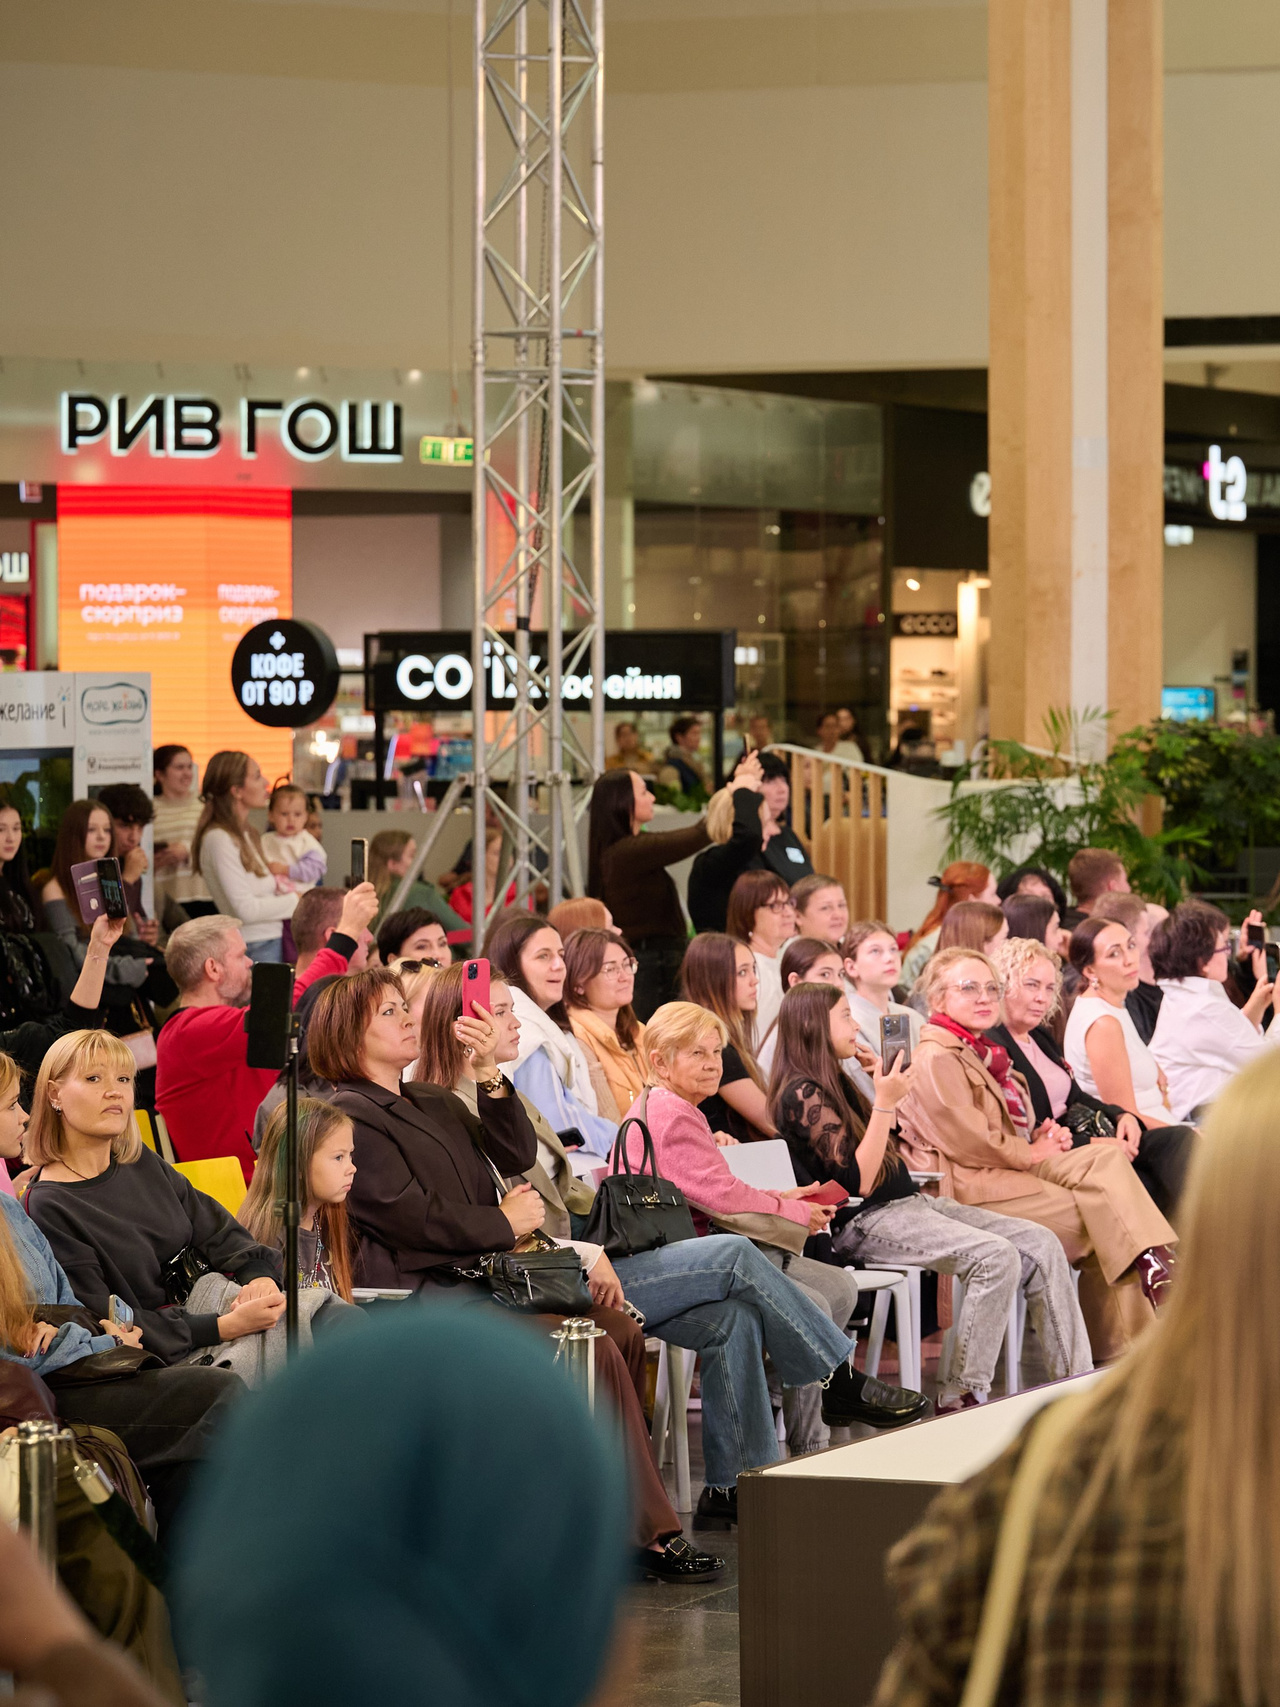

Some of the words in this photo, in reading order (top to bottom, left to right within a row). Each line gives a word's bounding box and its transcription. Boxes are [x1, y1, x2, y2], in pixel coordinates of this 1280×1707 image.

[60, 391, 222, 458] РИВ
[239, 396, 404, 463] ГОШ
[1203, 444, 1247, 521] t2
[79, 583, 188, 604] подарок-
[81, 605, 184, 627] сюрприз
[250, 652, 305, 679] КОФЕ
[241, 680, 268, 706] ОТ
[268, 680, 297, 706] 90
